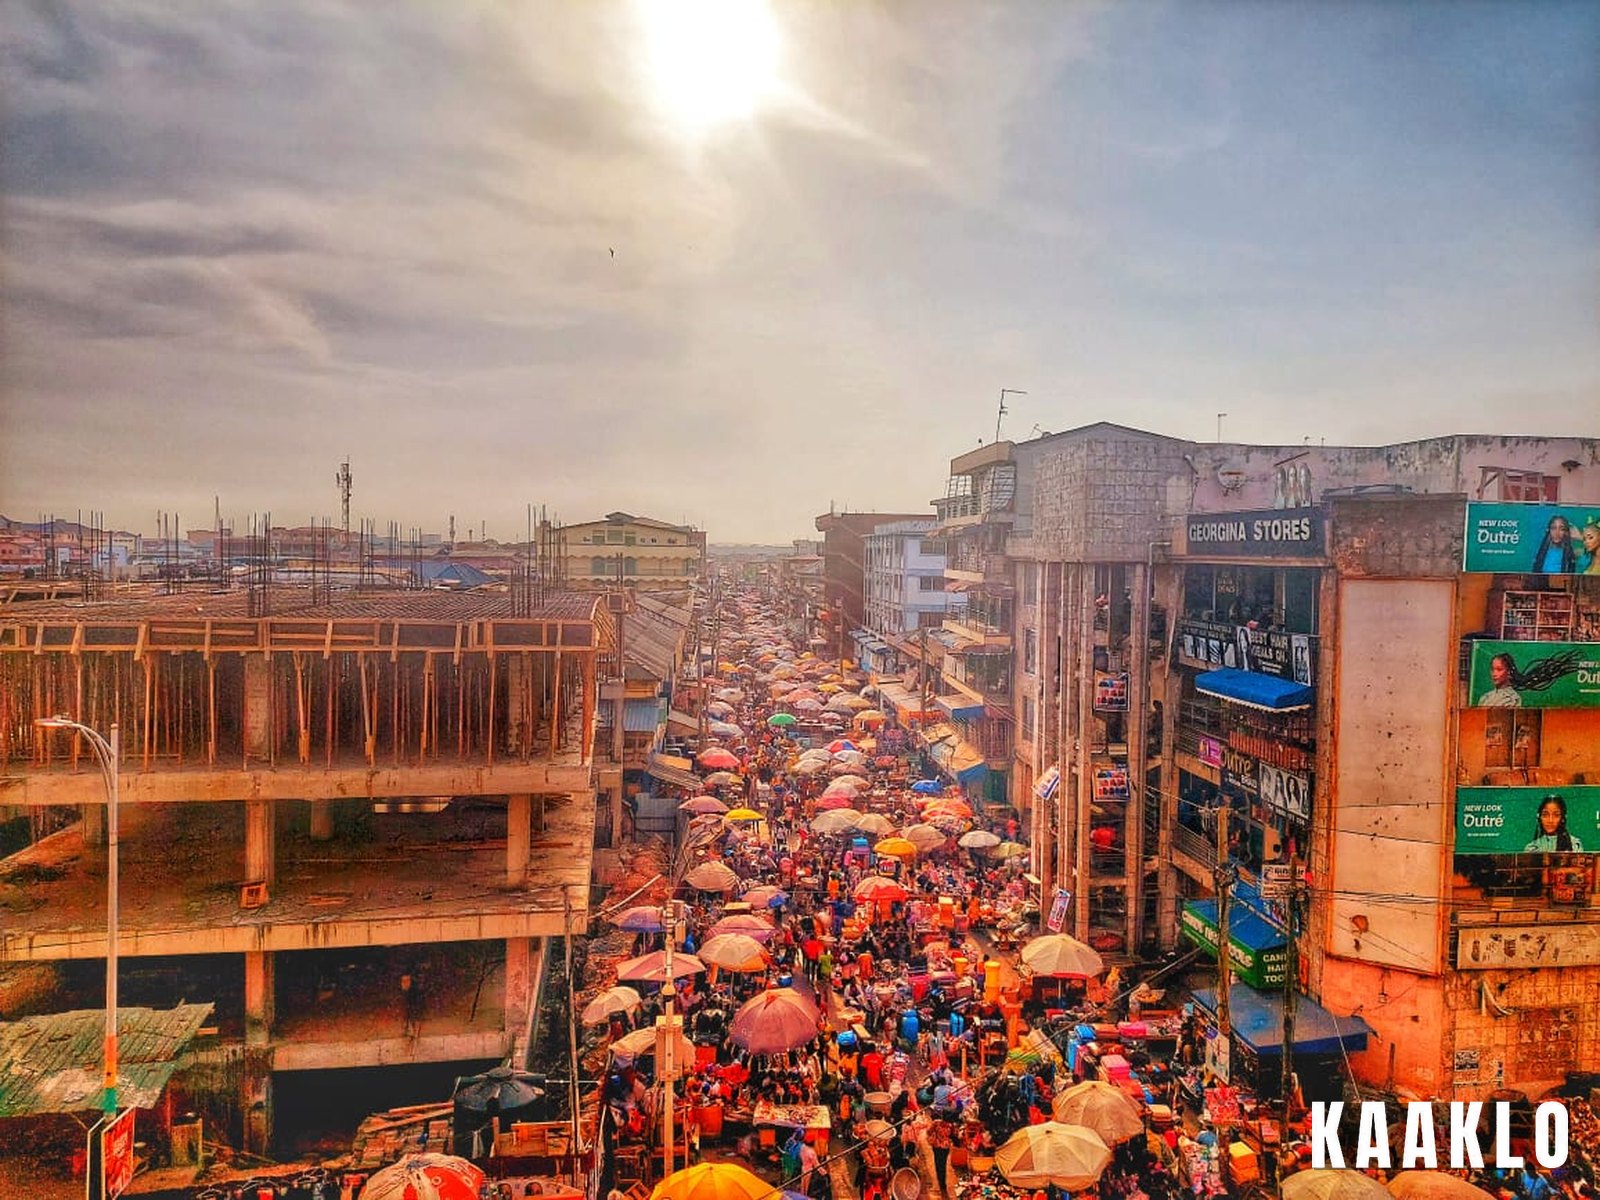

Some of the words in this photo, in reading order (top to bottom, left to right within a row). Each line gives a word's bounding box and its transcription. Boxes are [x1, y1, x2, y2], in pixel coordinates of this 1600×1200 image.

[1189, 521, 1246, 542] GEORGINA
[1253, 517, 1311, 541] STORES
[1479, 519, 1497, 527] NEW
[1497, 519, 1519, 528] LOOK
[1477, 529, 1520, 544] Outré
[1577, 670, 1600, 683] Out
[1464, 804, 1481, 812] NEW
[1482, 804, 1503, 812] LOOK
[1463, 813, 1504, 828] Outré
